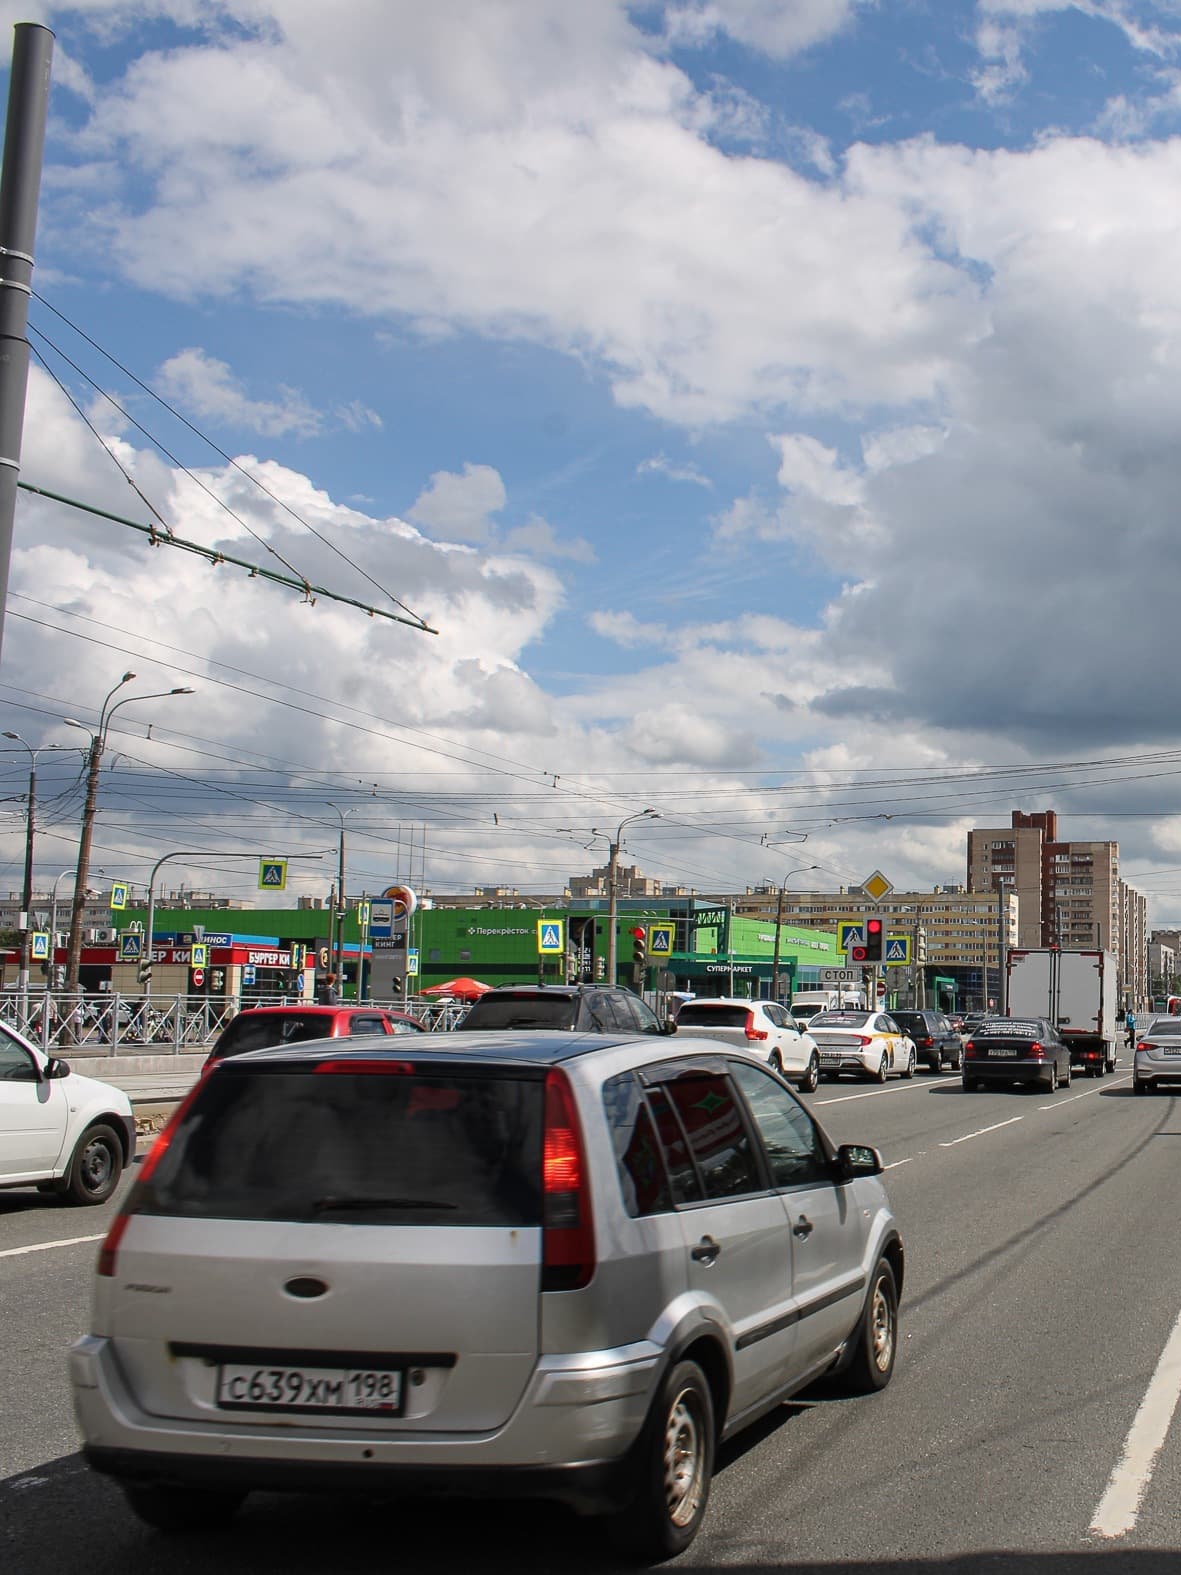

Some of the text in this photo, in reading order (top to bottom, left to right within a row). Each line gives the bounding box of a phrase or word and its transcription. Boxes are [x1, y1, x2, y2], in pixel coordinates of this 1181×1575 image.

[248, 951, 277, 965] БУРГЕР
[706, 965, 753, 973] СУПЕРМАРКЕТ
[824, 970, 854, 980] СТОП
[228, 1370, 396, 1404] С639ХМ 198
